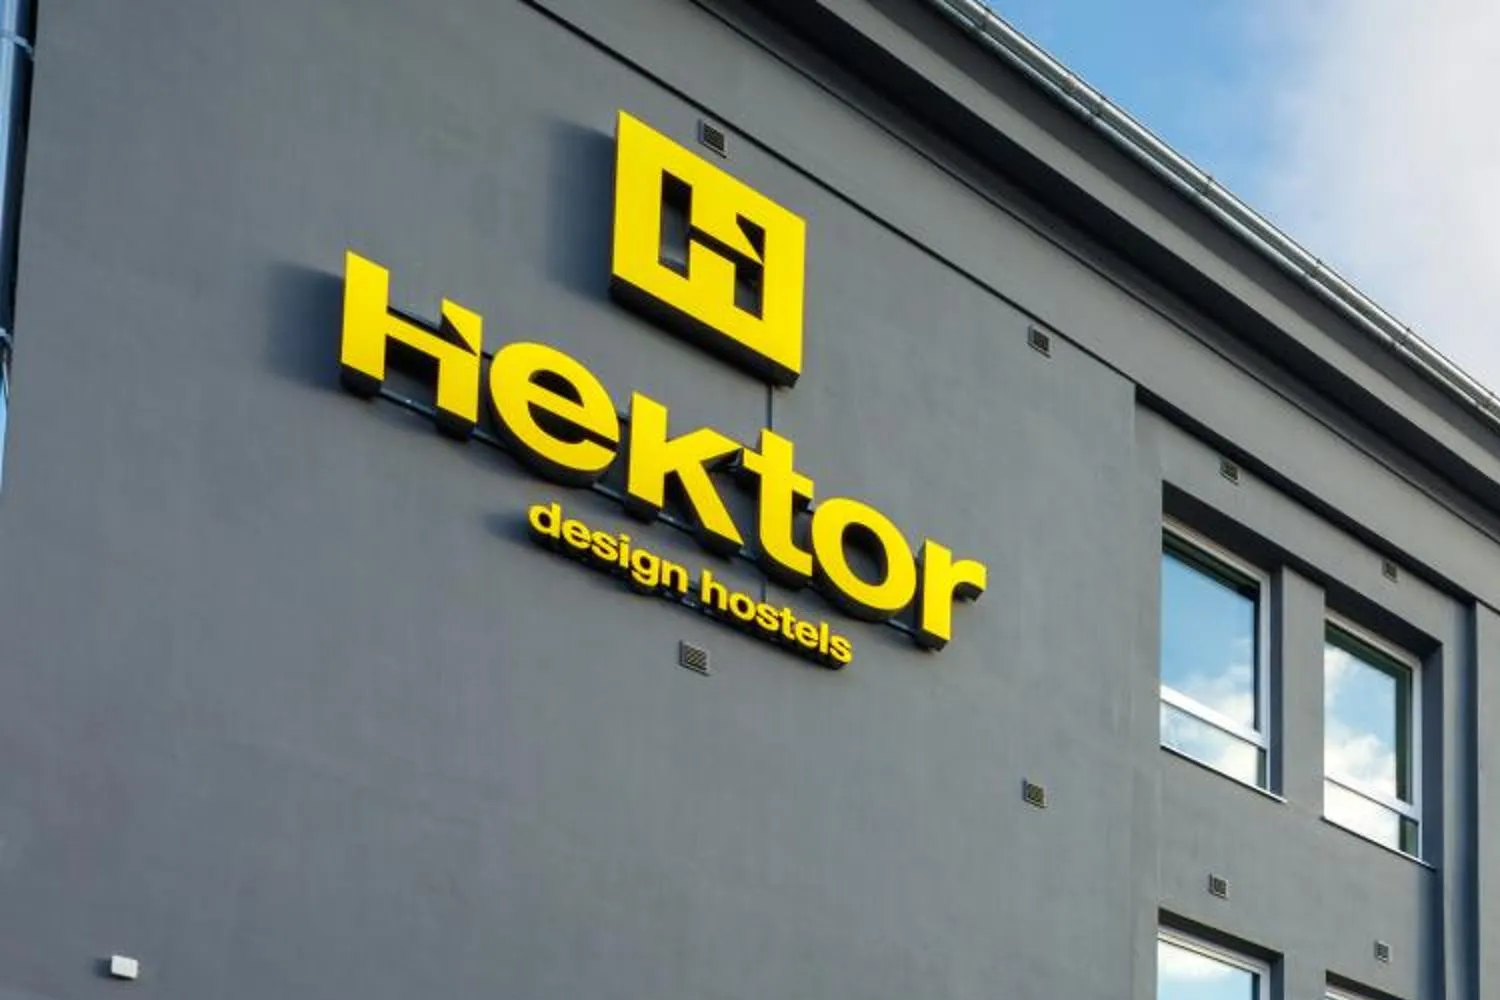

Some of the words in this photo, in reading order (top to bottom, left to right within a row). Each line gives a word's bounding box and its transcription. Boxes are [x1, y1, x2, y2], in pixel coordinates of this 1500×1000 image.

[340, 250, 988, 642] Hektor
[527, 501, 690, 594] design
[700, 568, 854, 664] hostels
